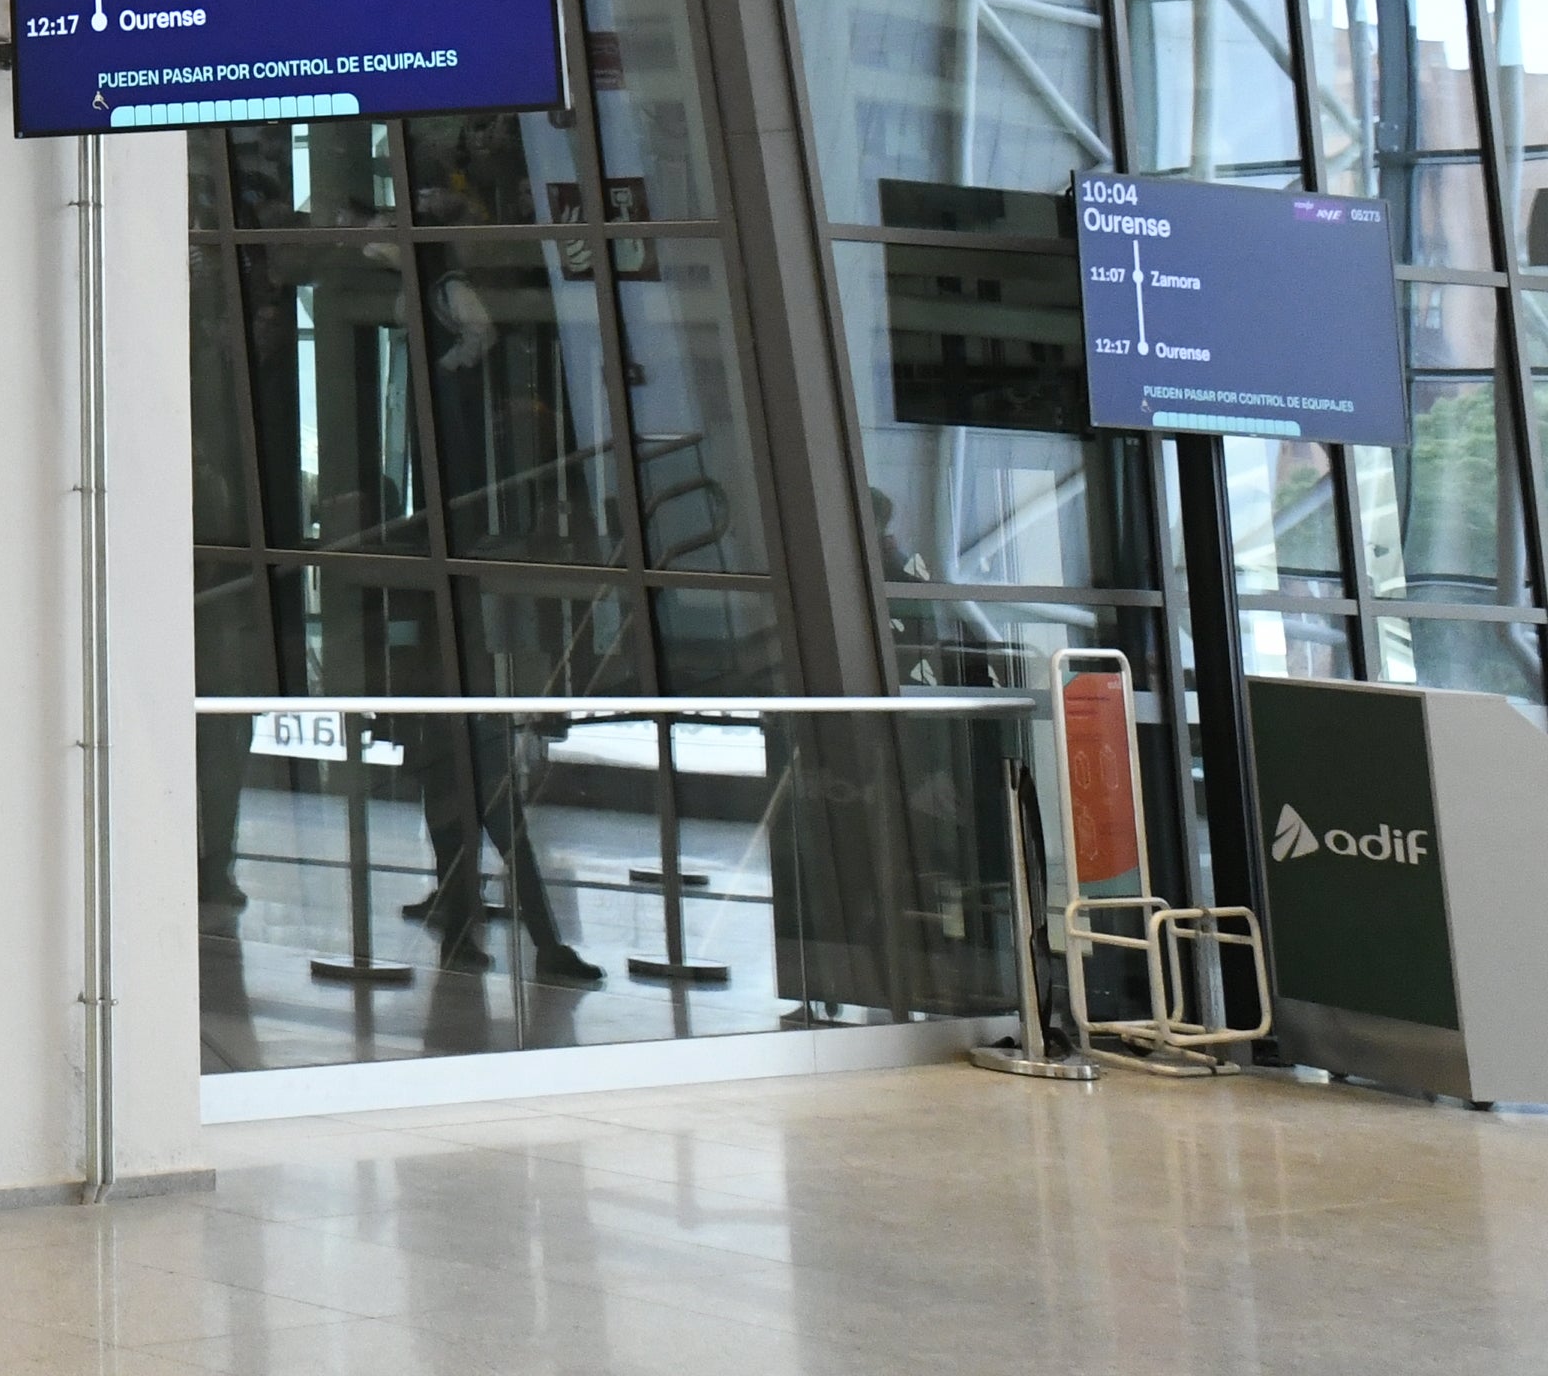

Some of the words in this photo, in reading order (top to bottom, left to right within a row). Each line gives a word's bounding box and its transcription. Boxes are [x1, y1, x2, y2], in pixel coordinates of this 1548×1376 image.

[26, 15, 79, 37] 12:17
[119, 9, 206, 31] Ourense
[98, 71, 159, 88] PUEDEN
[163, 66, 214, 84] PASAR
[217, 63, 250, 81] POR
[253, 57, 332, 79] CONTROL
[337, 56, 360, 74] DE
[363, 49, 458, 73] EQUIPAJES
[1082, 180, 1138, 205] 10:04
[1084, 207, 1171, 238] Ourense
[1350, 208, 1381, 223] 05273
[1090, 266, 1125, 283] 11:07
[1150, 271, 1201, 290] Zamora
[1095, 338, 1131, 354] 12:17
[1155, 342, 1211, 362] Ourense
[1143, 385, 1183, 399] PUEDEN
[1185, 388, 1216, 403] PASAR
[1217, 391, 1238, 404] POR
[1239, 392, 1286, 408] CONTROL
[1287, 396, 1300, 409] DE
[1302, 397, 1355, 413] EQUIPAJES
[1324, 823, 1428, 865] adif
